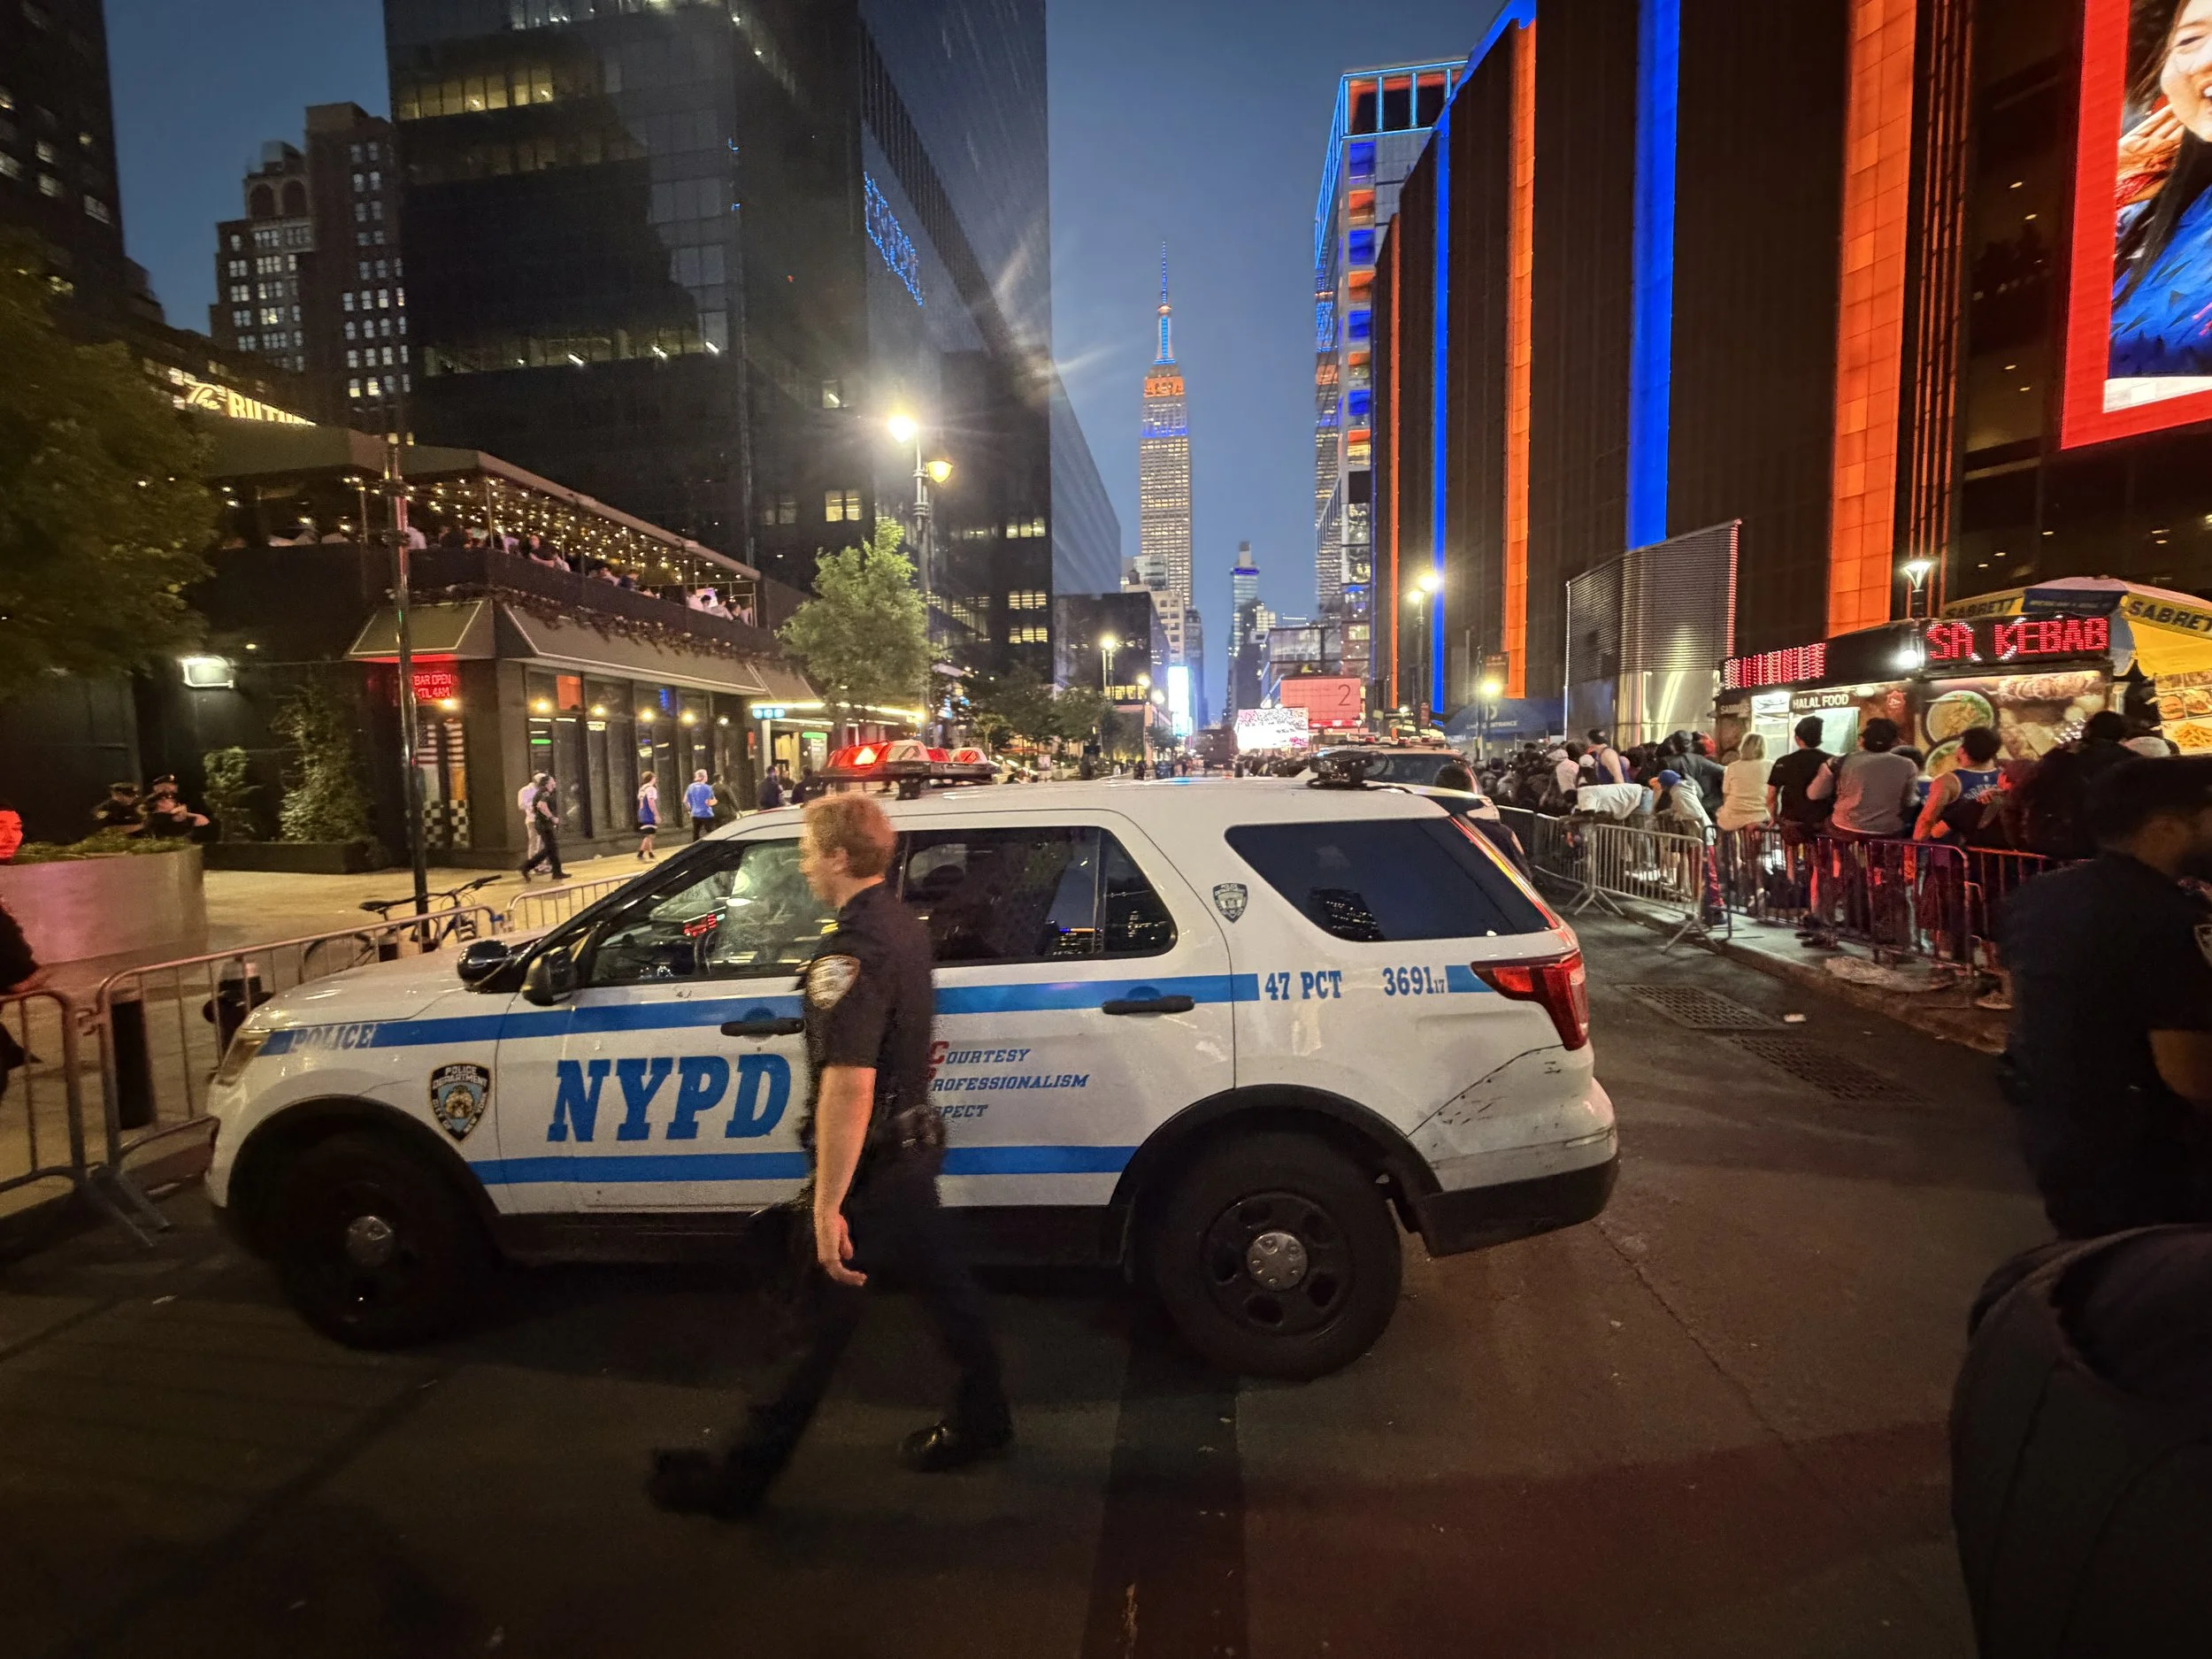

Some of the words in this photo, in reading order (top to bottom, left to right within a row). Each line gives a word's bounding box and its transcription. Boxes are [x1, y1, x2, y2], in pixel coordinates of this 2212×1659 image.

[1994, 618, 2108, 661] KEBAB
[413, 674, 431, 686] BAR
[431, 673, 451, 685] OPEN
[1337, 684, 1351, 706] 2
[1792, 695, 1821, 710] HALAL
[1822, 693, 1849, 707] FOOD
[1264, 972, 1291, 1001] 47
[1300, 970, 1342, 1000] PCT
[1382, 966, 1434, 996] 3691
[288, 1024, 377, 1054] POLICE
[928, 1041, 1032, 1064] COURTESY
[444, 1064, 478, 1076] POLICE
[432, 1073, 488, 1090] DEPARTMENT
[547, 1054, 792, 1142] NYPD
